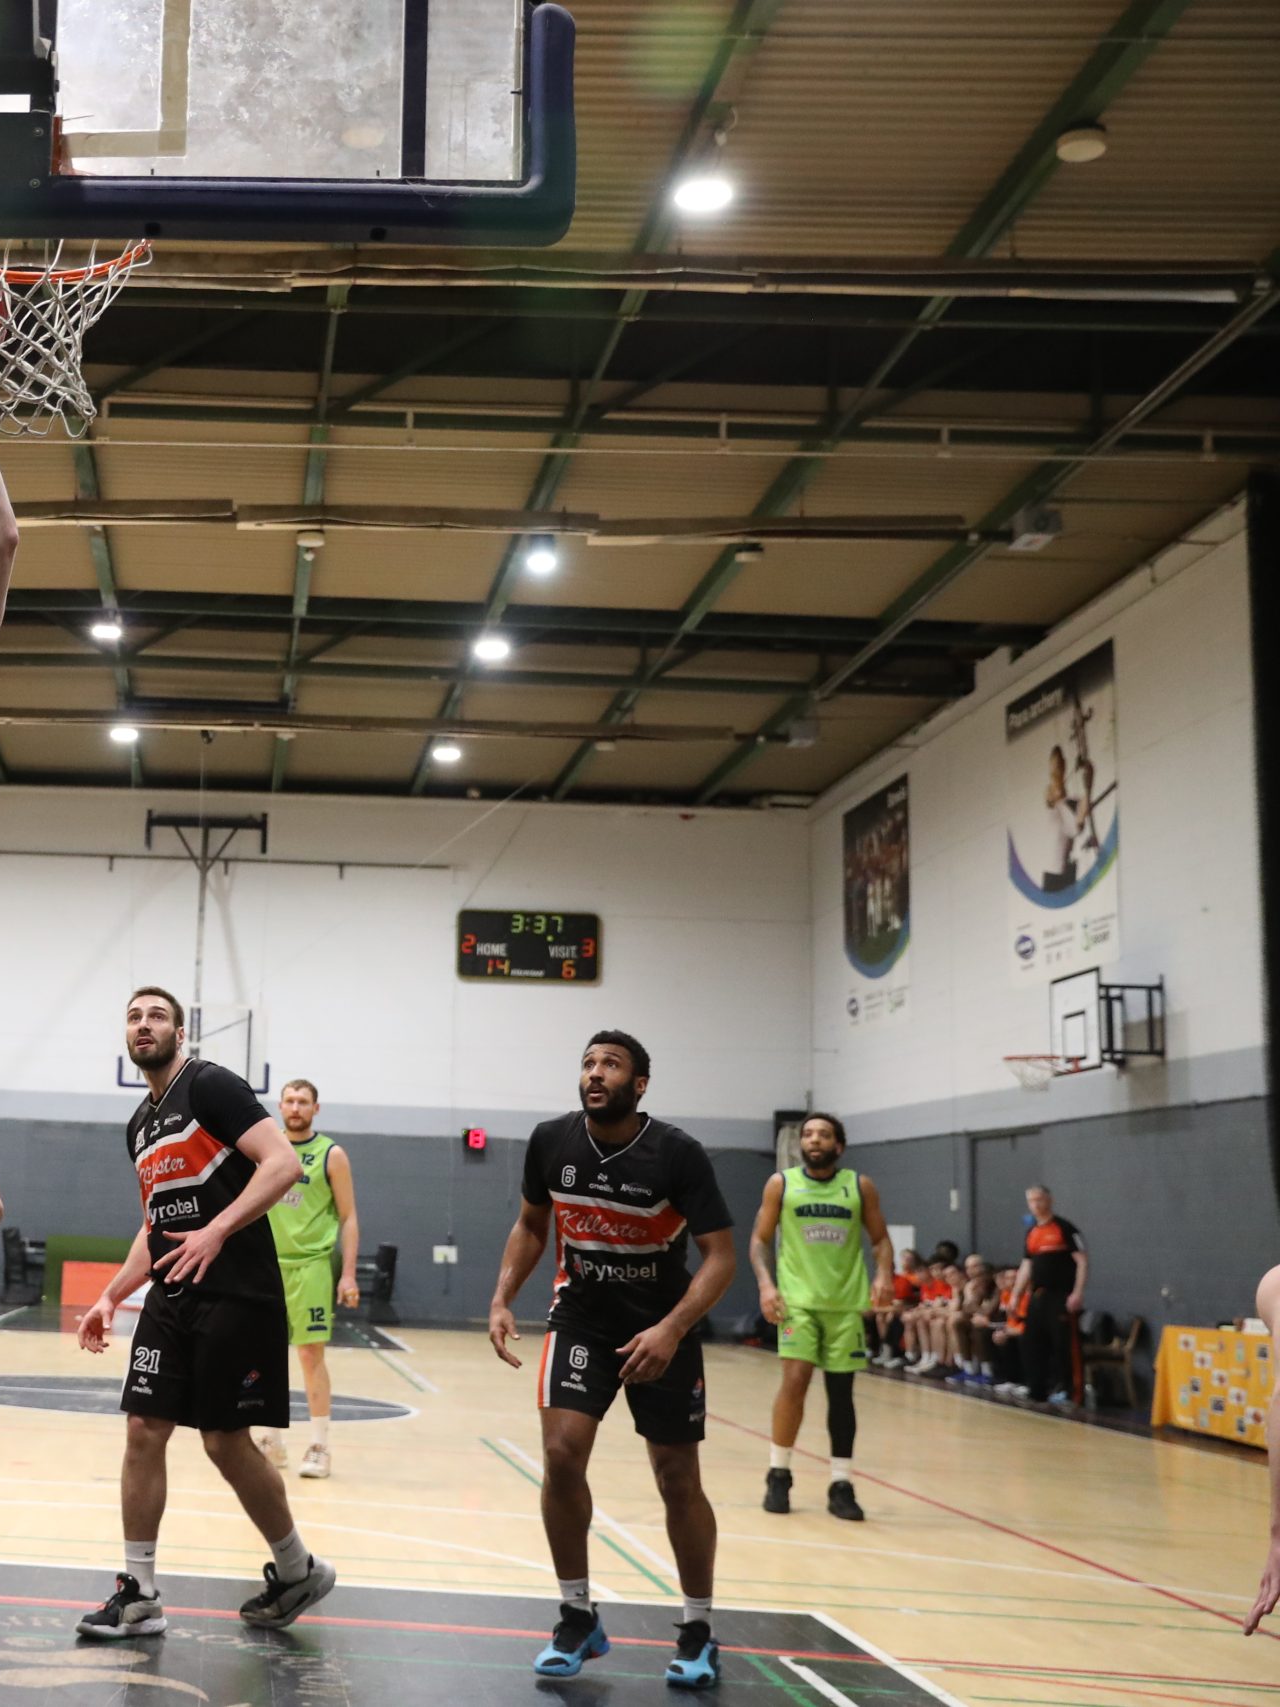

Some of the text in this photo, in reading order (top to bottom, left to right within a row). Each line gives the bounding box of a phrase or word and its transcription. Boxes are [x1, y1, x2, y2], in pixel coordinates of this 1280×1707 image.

[511, 914, 564, 934] 3:37
[461, 934, 477, 954] 2
[476, 943, 508, 957] HOME
[581, 938, 596, 958] 3
[487, 959, 511, 976] 14
[561, 959, 577, 980] 6
[301, 1153, 315, 1166] 12
[561, 1165, 577, 1188] 6
[148, 1196, 199, 1226] yrobel
[559, 1209, 648, 1239] Killester
[583, 1260, 657, 1282] Pyrobel
[307, 1307, 325, 1322] 12
[133, 1346, 161, 1374] 21
[569, 1344, 589, 1370] 6
